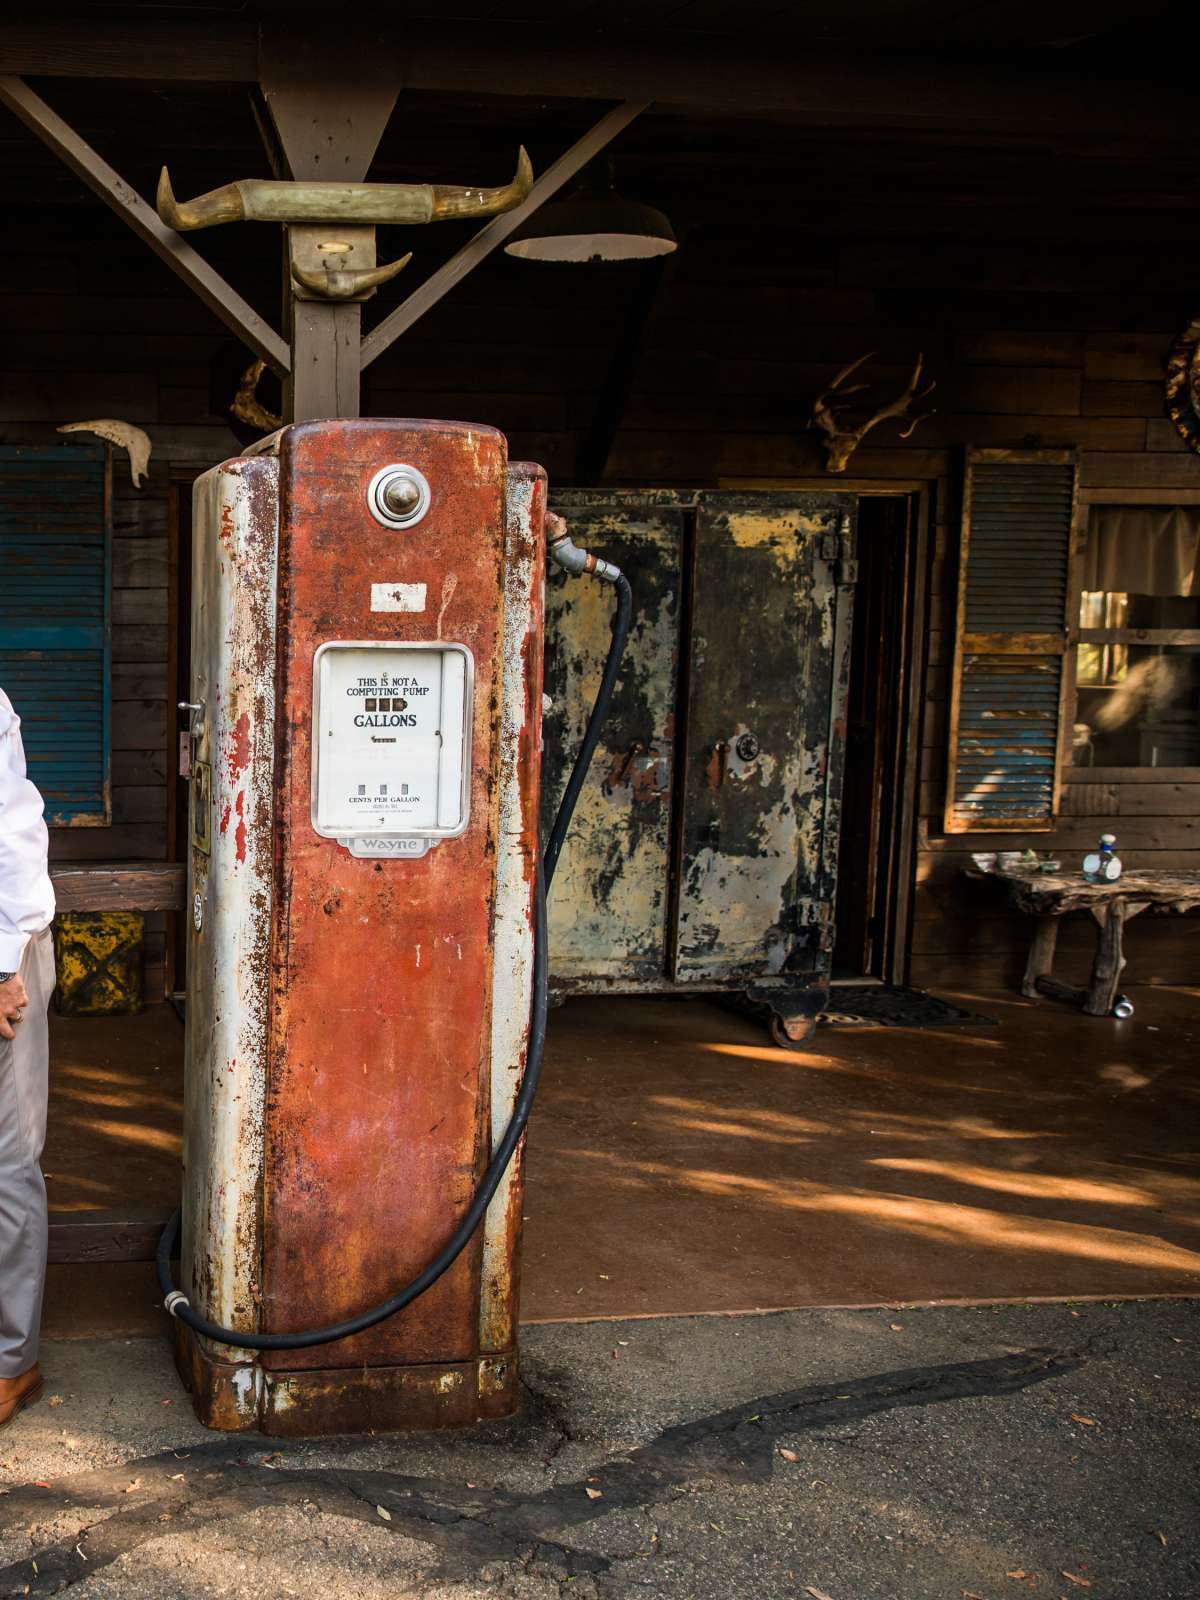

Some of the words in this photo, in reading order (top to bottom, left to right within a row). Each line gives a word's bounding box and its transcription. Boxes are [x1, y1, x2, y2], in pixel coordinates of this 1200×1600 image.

[357, 677, 378, 687] THIS
[380, 677, 389, 687] IS
[392, 677, 410, 687] NOT
[410, 677, 419, 687] A
[346, 687, 399, 697] COMPUTING
[402, 687, 430, 696] PUMP
[353, 714, 417, 728] GALLONS
[348, 796, 372, 804] CENTS
[361, 839, 418, 851] Wayne
